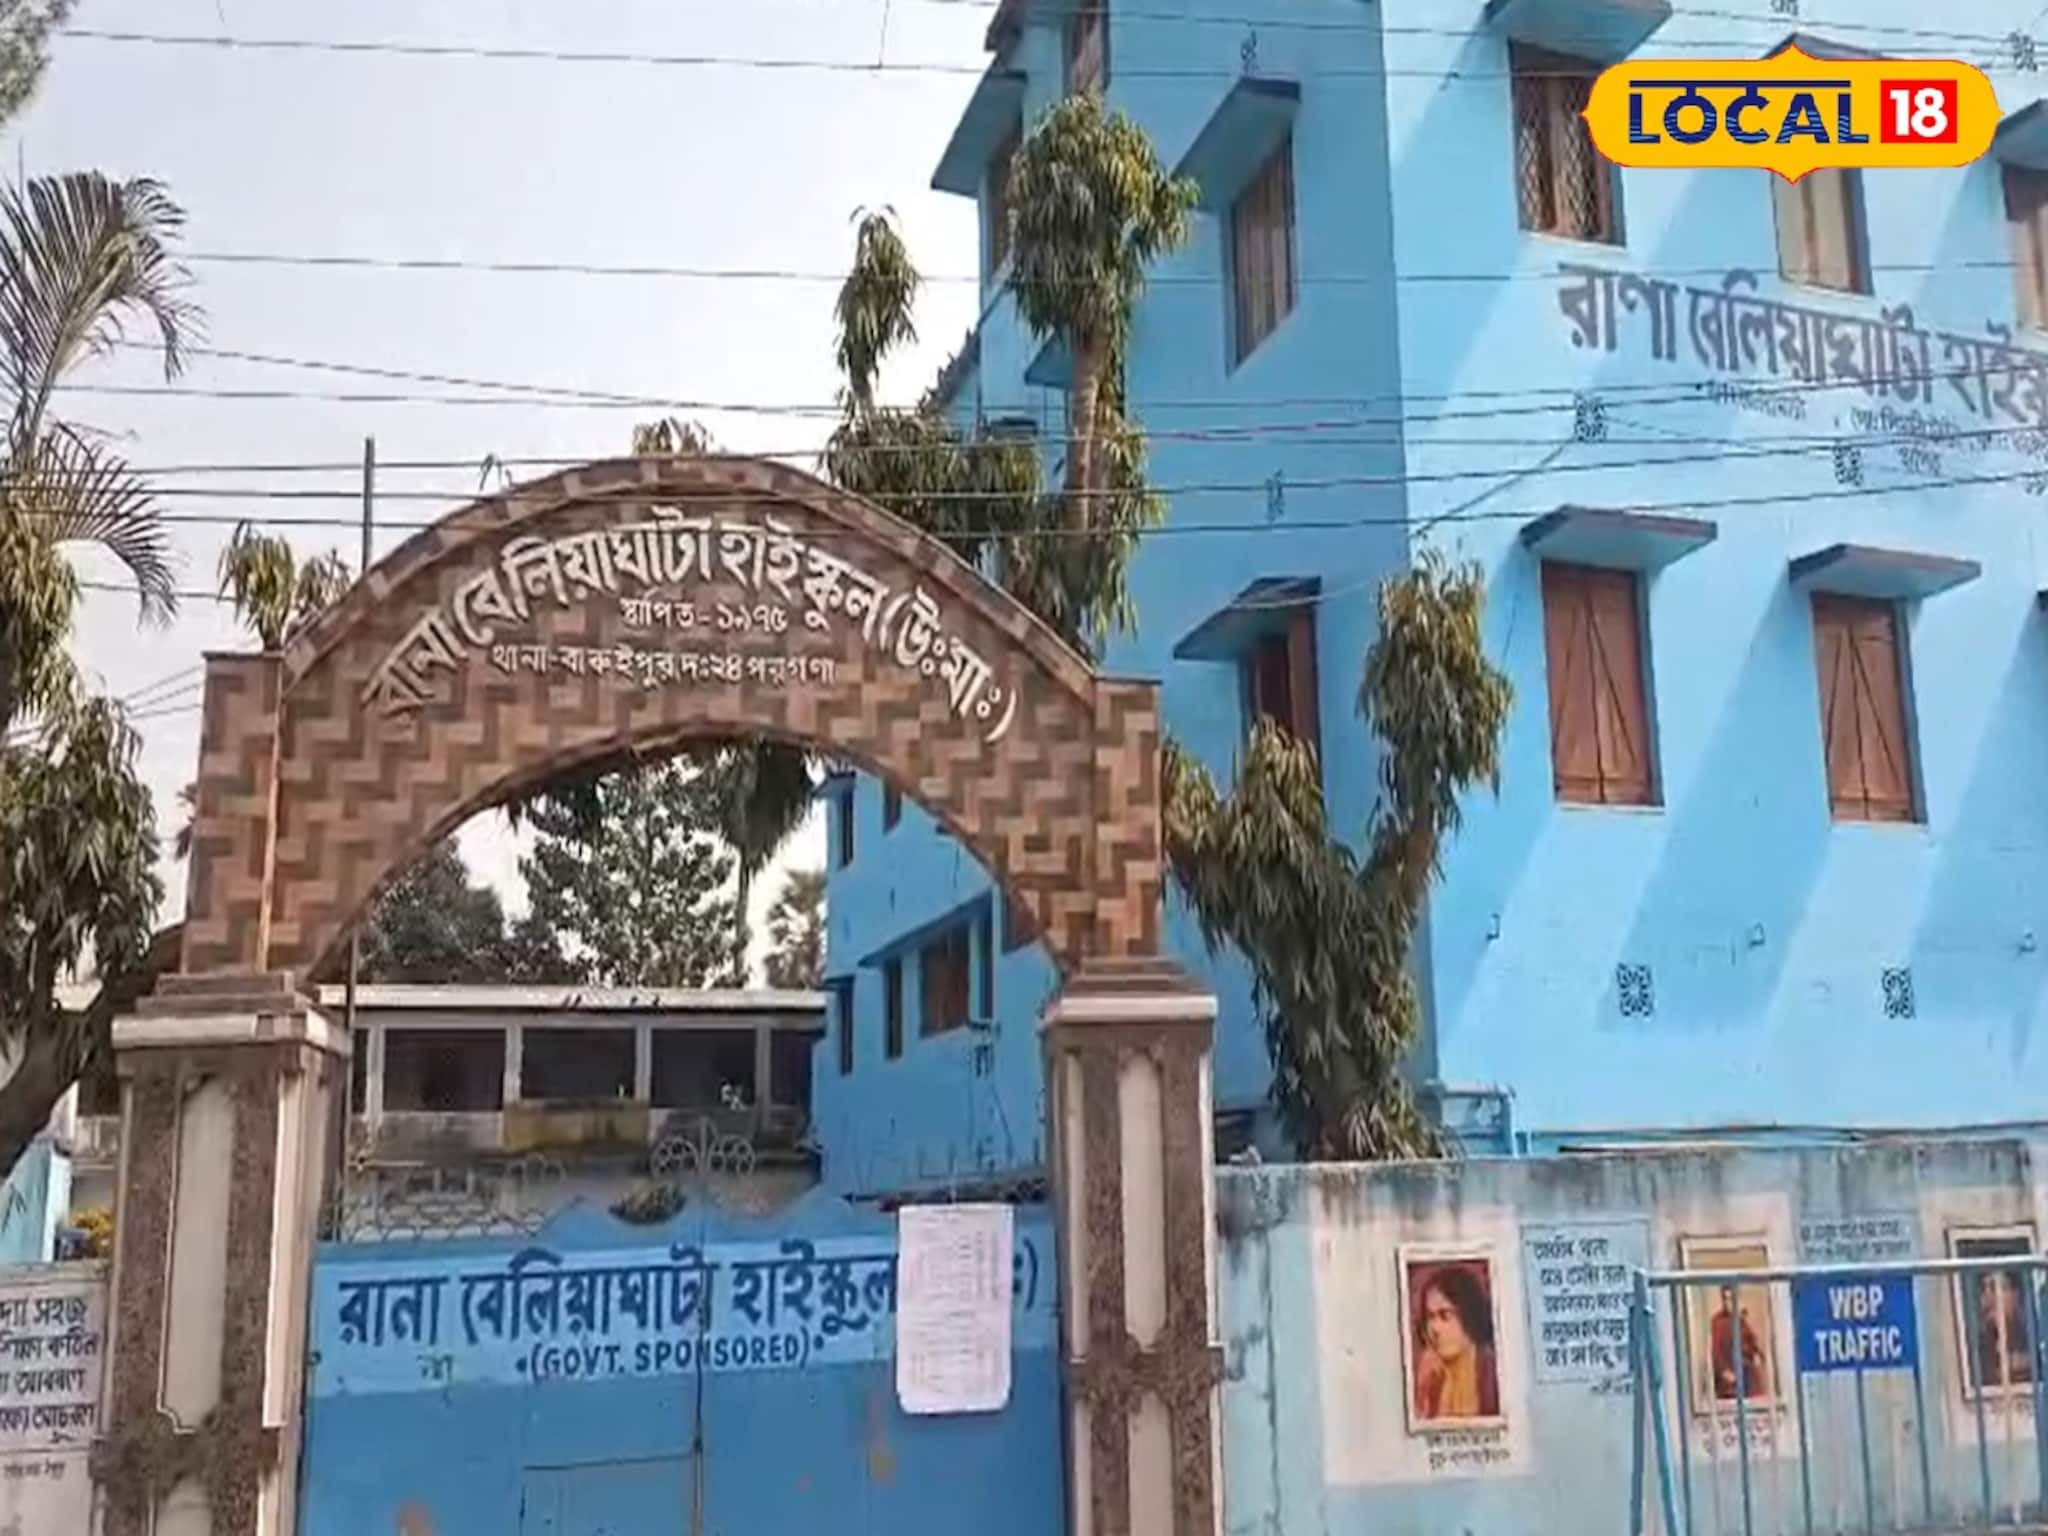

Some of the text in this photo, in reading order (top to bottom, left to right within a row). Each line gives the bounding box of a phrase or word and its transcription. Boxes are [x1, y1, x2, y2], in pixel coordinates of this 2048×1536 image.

[1558, 263, 1678, 362] রাণা
[360, 606, 468, 728] রানা
[453, 506, 712, 646] বেলিয়াঘাটা
[338, 1276, 449, 1347] রানা
[459, 1245, 720, 1345] বেলিয়াঘাটা
[730, 1238, 898, 1335] হাইস্কুল
[1828, 1284, 1884, 1319] WBP
[531, 1326, 810, 1382] (GOVT. SPONSORED)
[1814, 1324, 1903, 1364] TRAFFIC
